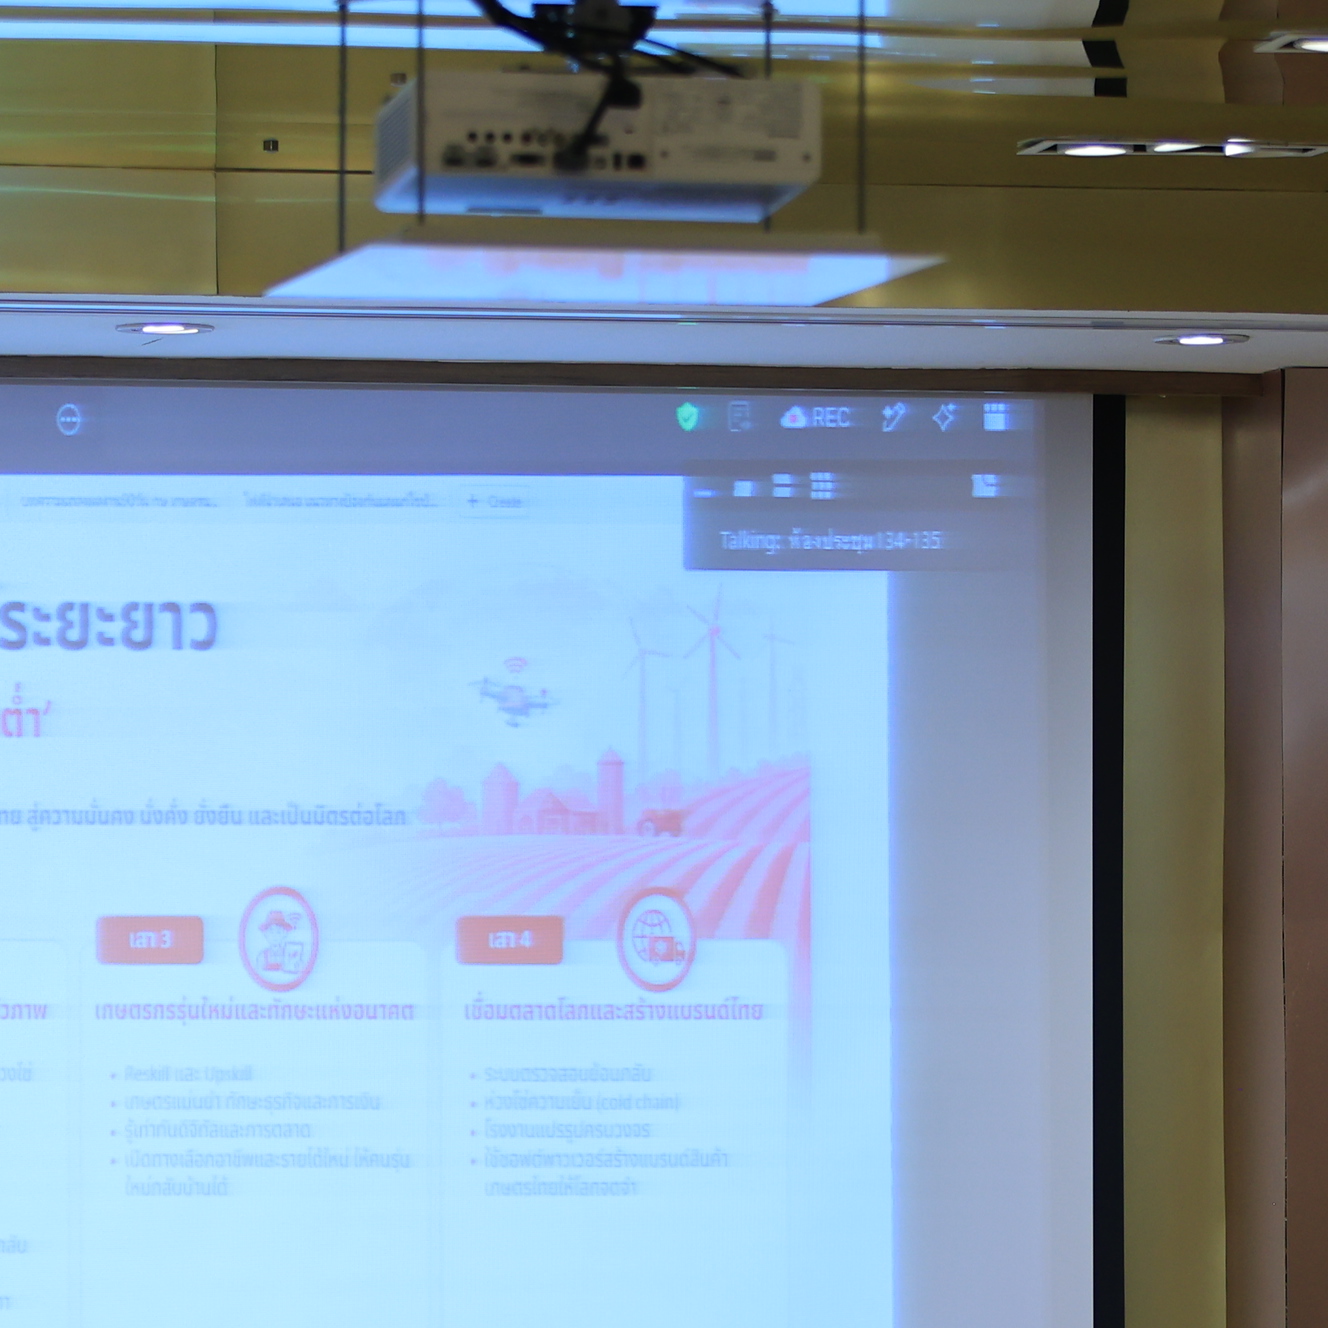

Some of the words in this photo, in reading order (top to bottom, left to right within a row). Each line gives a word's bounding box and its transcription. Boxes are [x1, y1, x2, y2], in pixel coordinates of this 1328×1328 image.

[813, 406, 851, 427] REC
[719, 530, 781, 554] Talking:
[194, 797, 242, 826] ยั่งยืน
[248, 800, 406, 826] และเป็นมิตรต่อโลก
[129, 930, 155, 949] เสา
[161, 932, 173, 949] 3
[488, 931, 515, 949] เสา
[520, 932, 532, 949] 4
[95, 997, 415, 1027] เกษตรกรรุ่นใหม่และทักษะแห่งอนาคต
[465, 990, 764, 1021] เชื่อมตลาดโลกและสร้างแบรนด์ไทย
